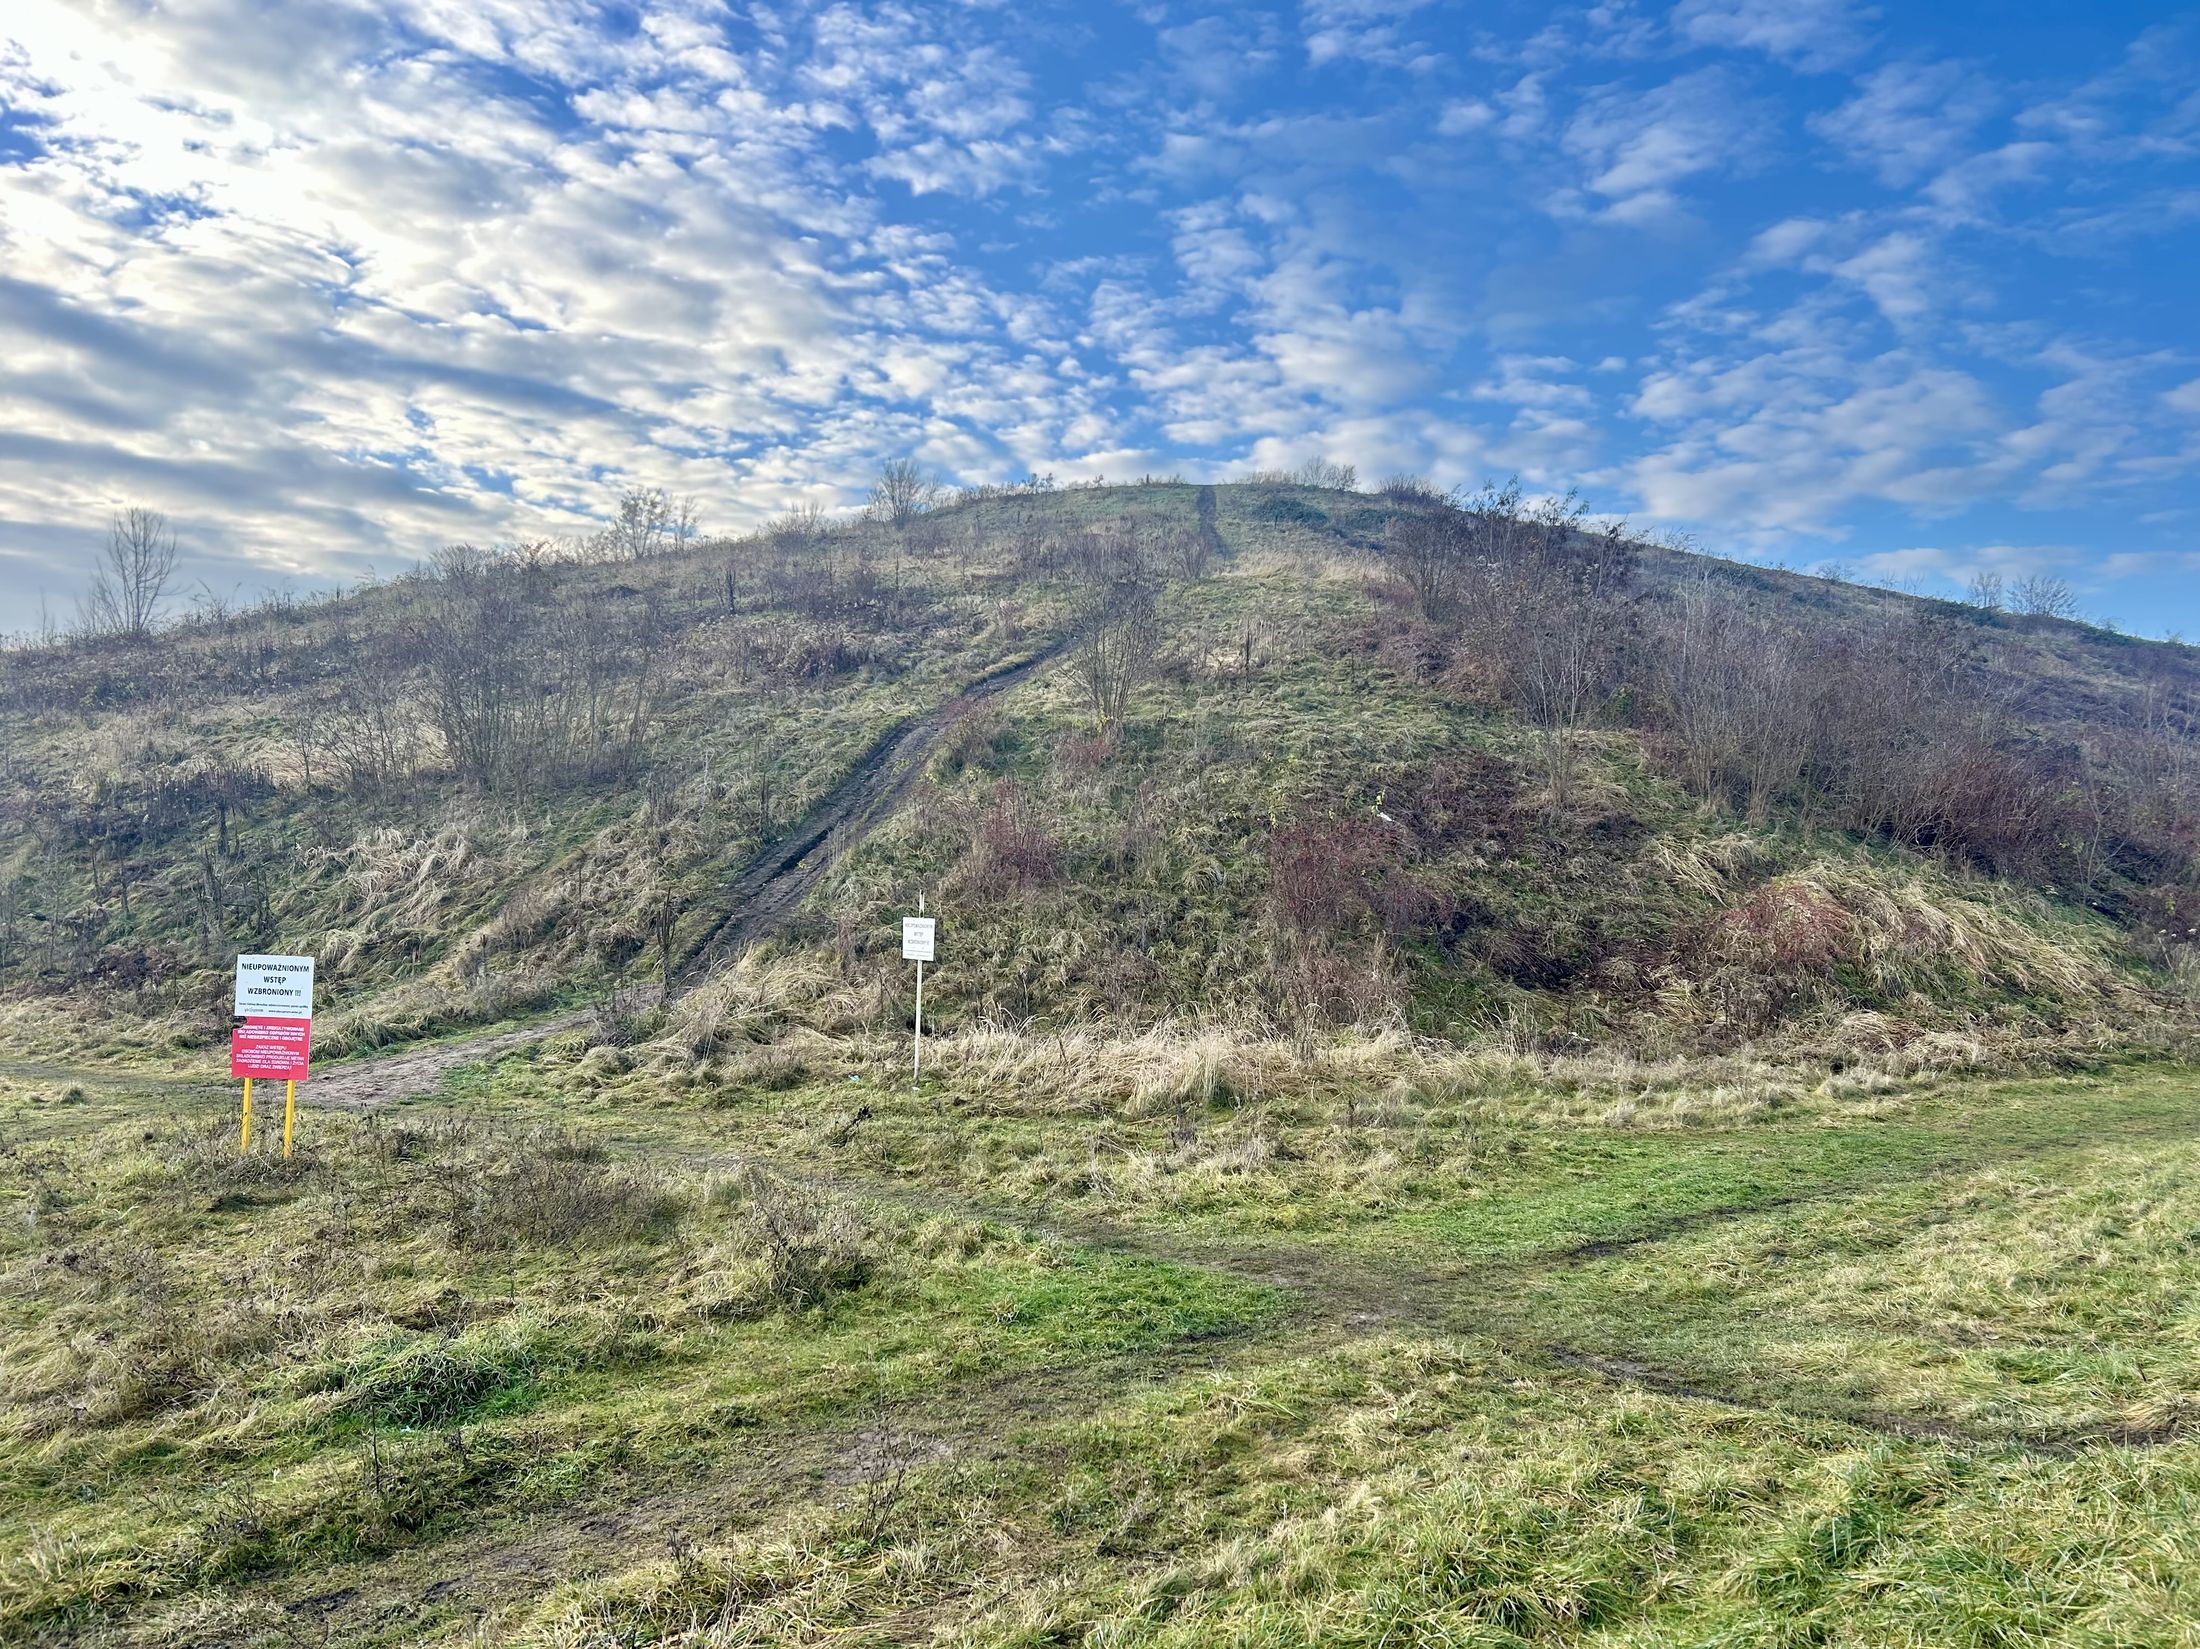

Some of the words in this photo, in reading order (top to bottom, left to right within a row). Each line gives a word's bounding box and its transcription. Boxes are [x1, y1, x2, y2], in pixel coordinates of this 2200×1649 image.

[241, 963, 310, 972] NIEUPOWAŻNIONYM
[263, 975, 287, 985] WSTĘP
[247, 987, 294, 996] WZBRONIONY
